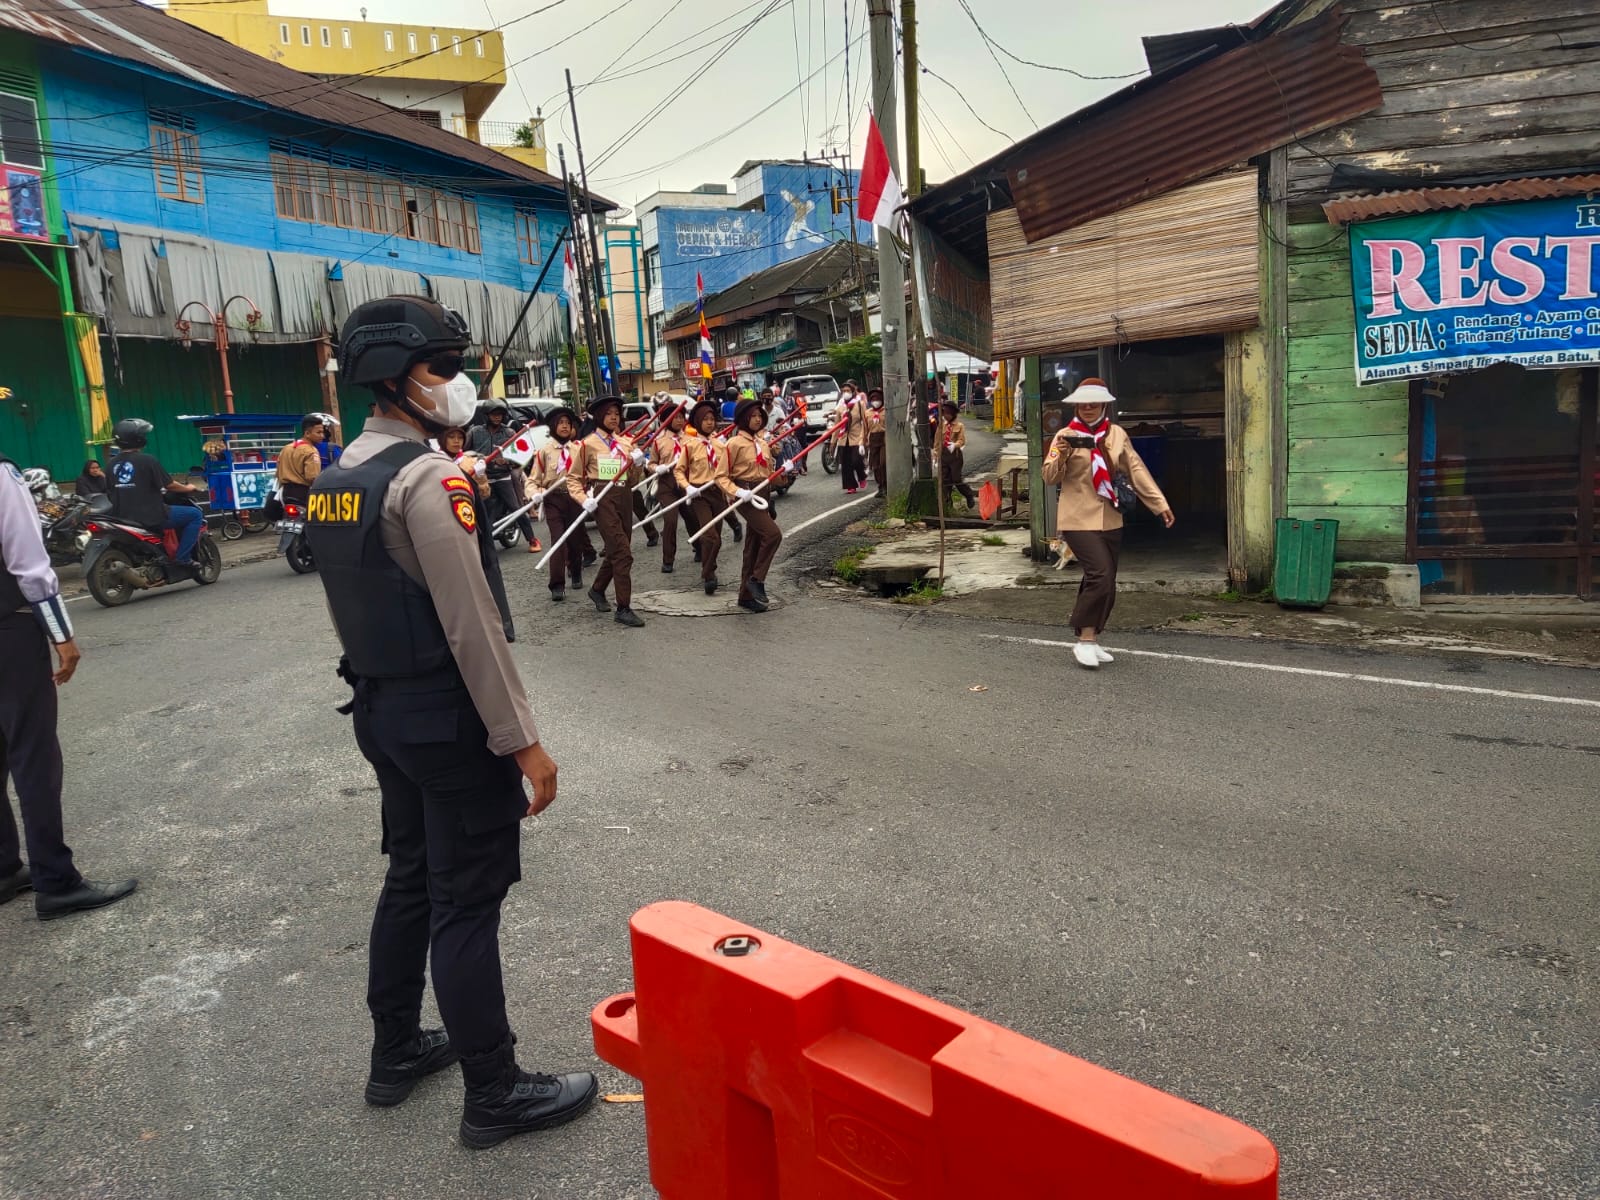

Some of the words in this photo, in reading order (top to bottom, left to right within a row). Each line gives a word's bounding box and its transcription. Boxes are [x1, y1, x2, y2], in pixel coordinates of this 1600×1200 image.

[1363, 235, 1600, 319] REST
[1454, 312, 1522, 328] Rendang
[1535, 310, 1582, 324] Ayam
[1455, 329, 1516, 344] Pindang
[1516, 325, 1572, 339] Tulang
[1365, 364, 1411, 379] Alamat
[1421, 357, 1475, 371] Simpang
[307, 492, 361, 522] POLISI
